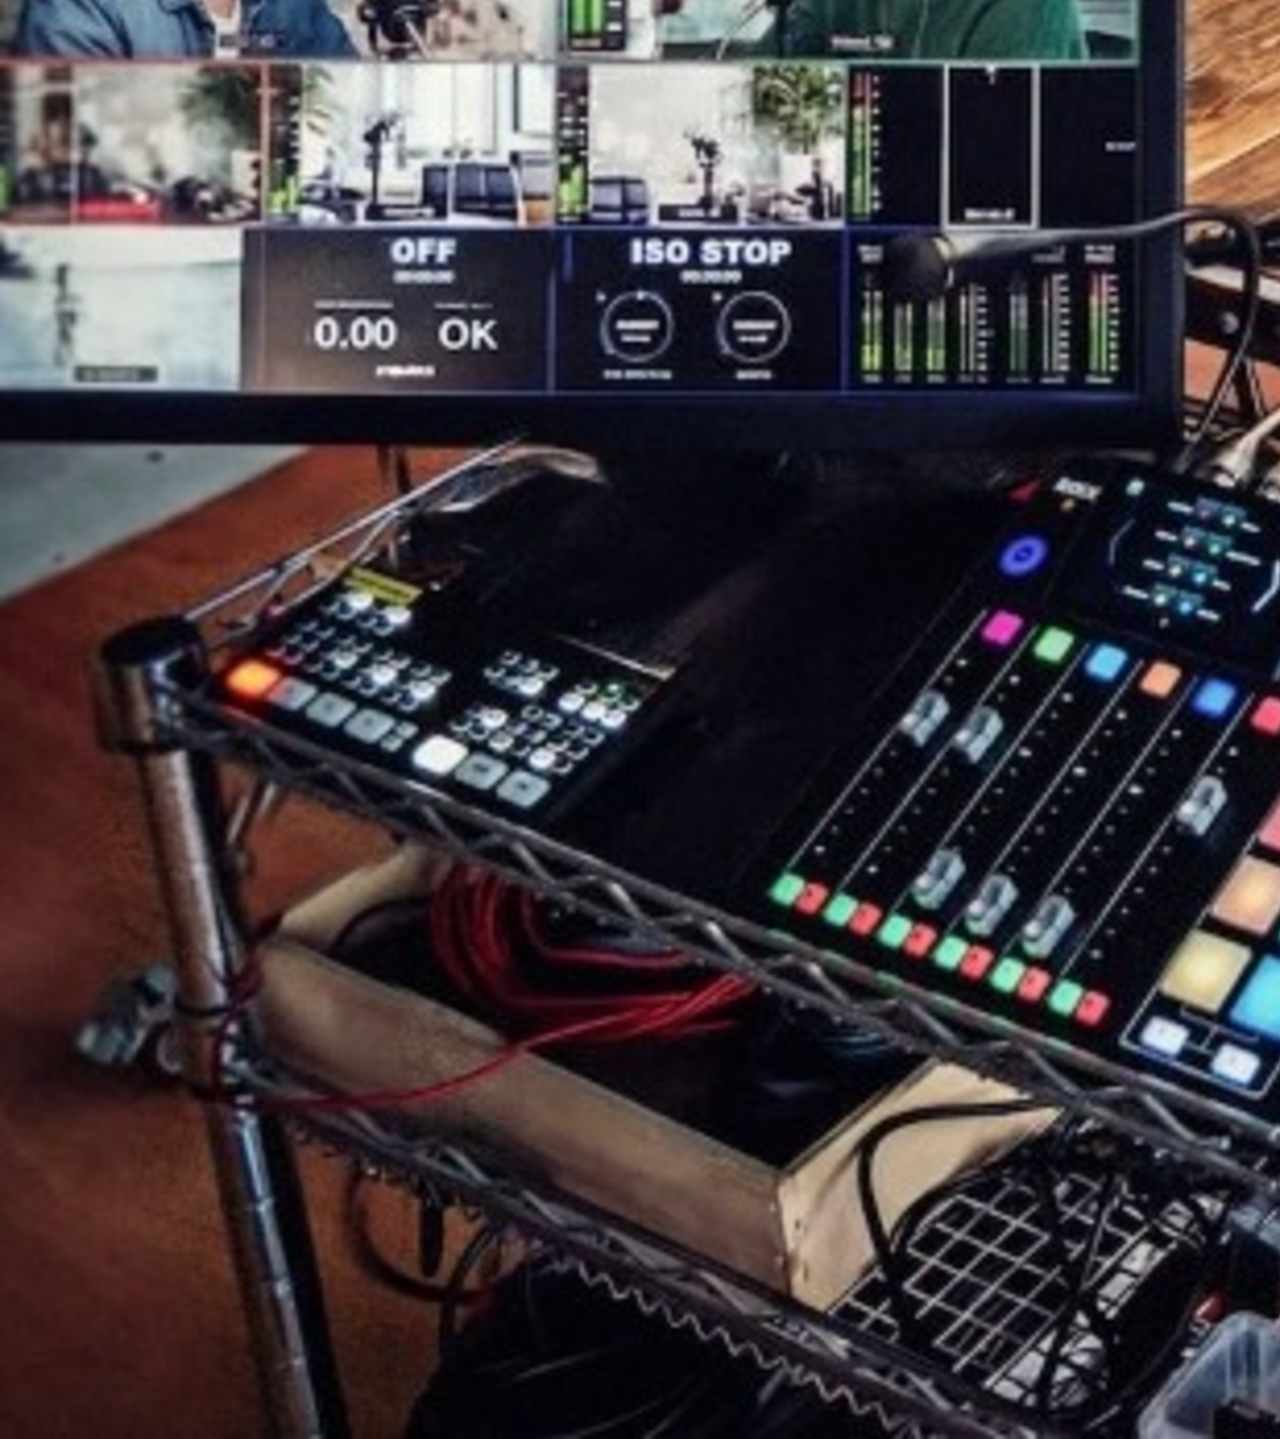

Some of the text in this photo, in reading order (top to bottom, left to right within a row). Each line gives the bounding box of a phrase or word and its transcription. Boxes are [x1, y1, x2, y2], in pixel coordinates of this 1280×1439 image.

[390, 237, 456, 264] OFF
[631, 238, 793, 266] ISO STOP
[313, 316, 397, 350] 0.00
[438, 317, 498, 351] OK
